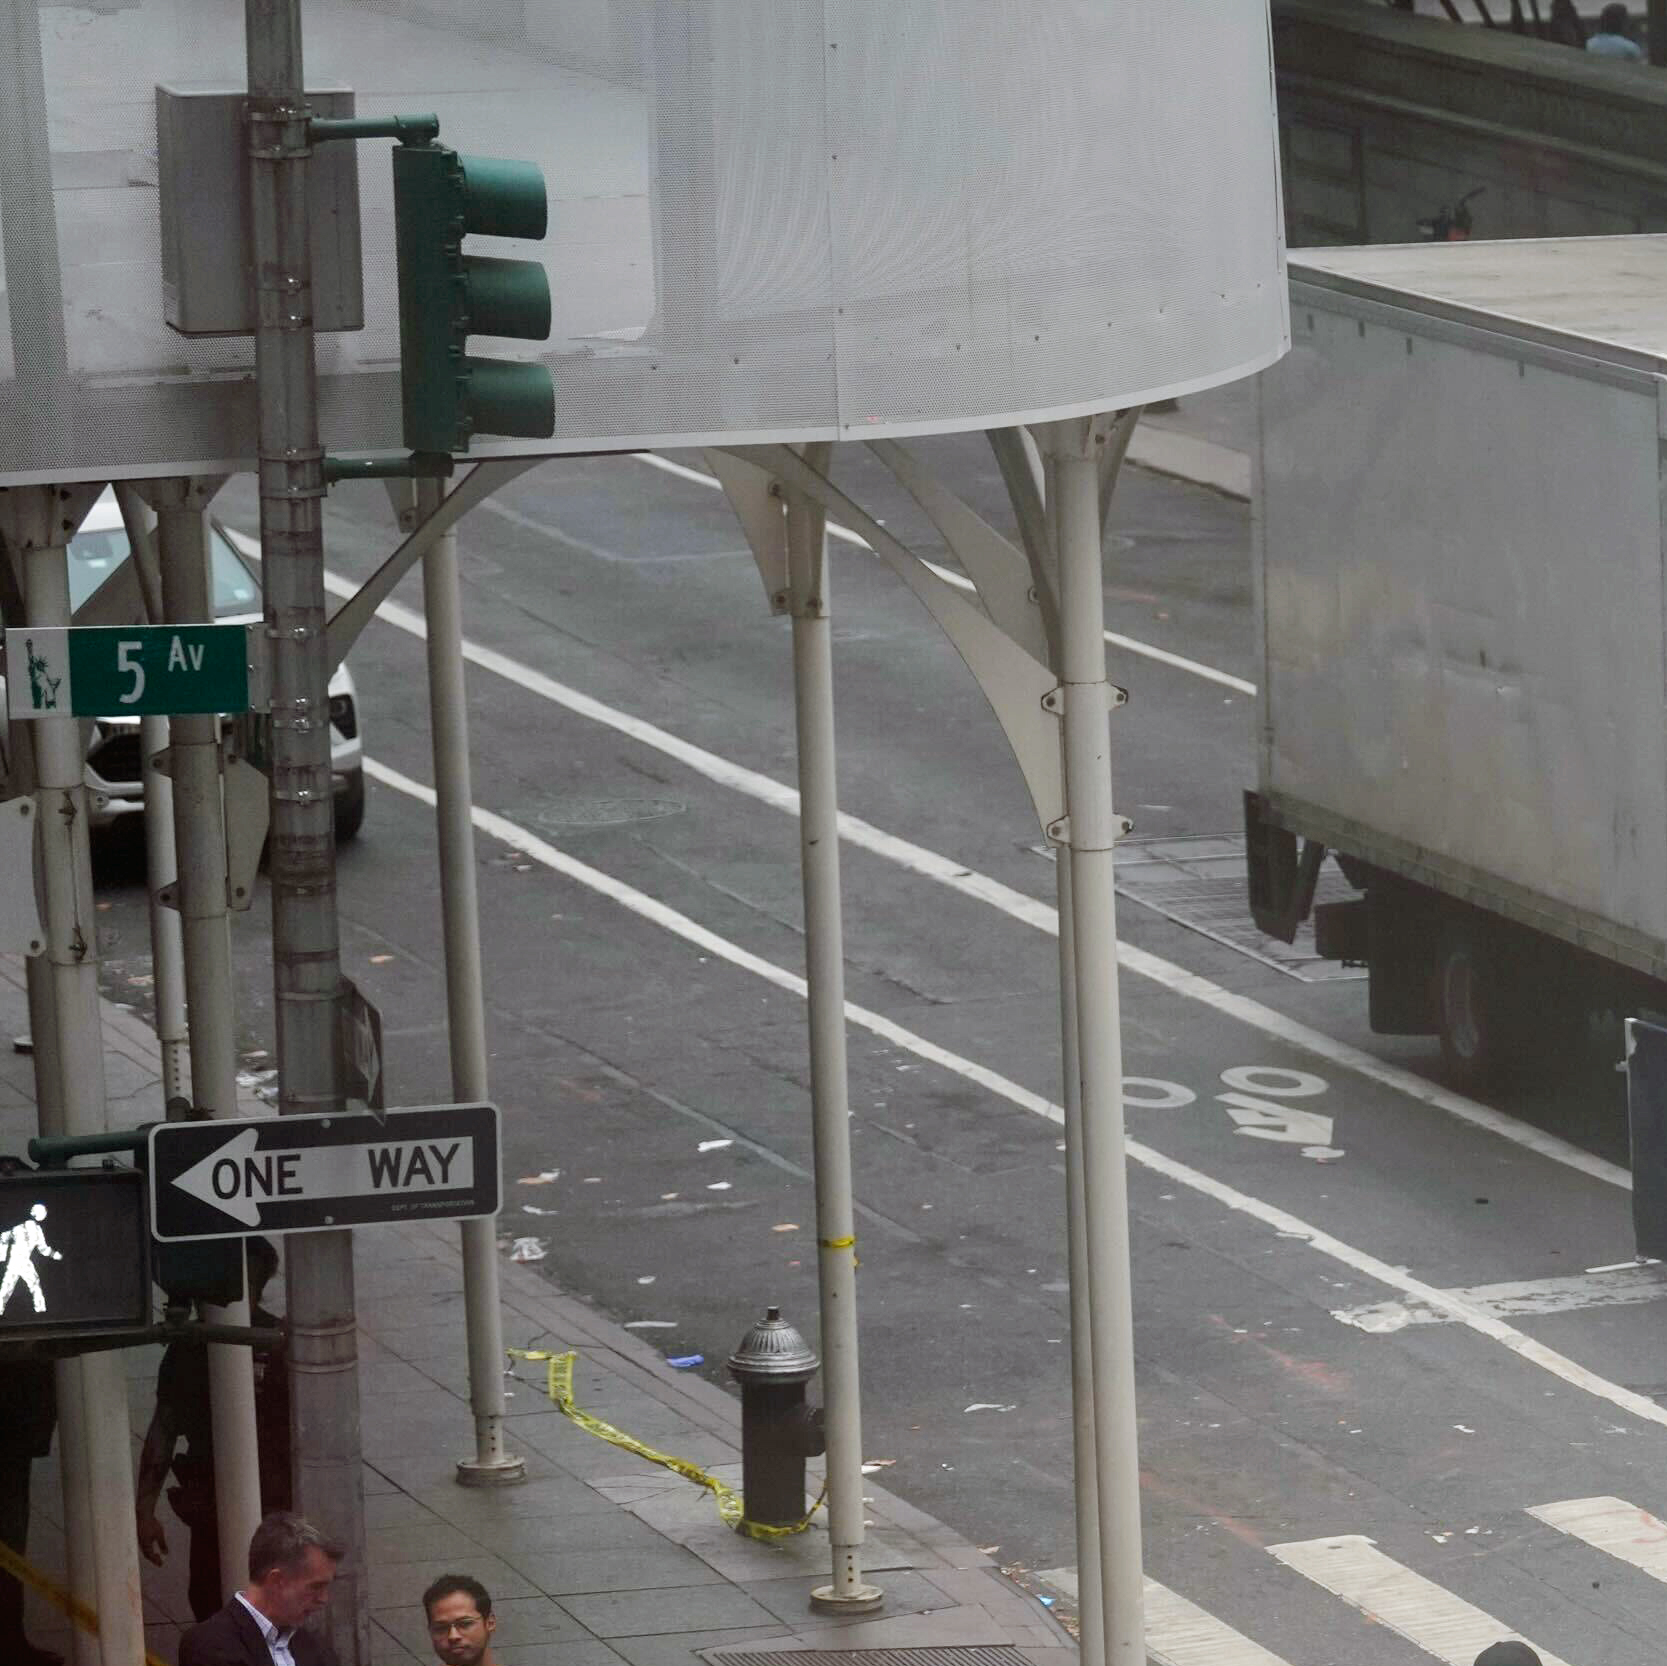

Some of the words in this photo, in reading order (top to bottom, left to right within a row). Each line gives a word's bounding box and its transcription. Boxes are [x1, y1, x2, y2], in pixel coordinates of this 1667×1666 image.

[117, 641, 146, 704] 5
[168, 635, 205, 672] Av
[212, 1153, 303, 1200] ONE
[368, 1143, 461, 1188] WAY
